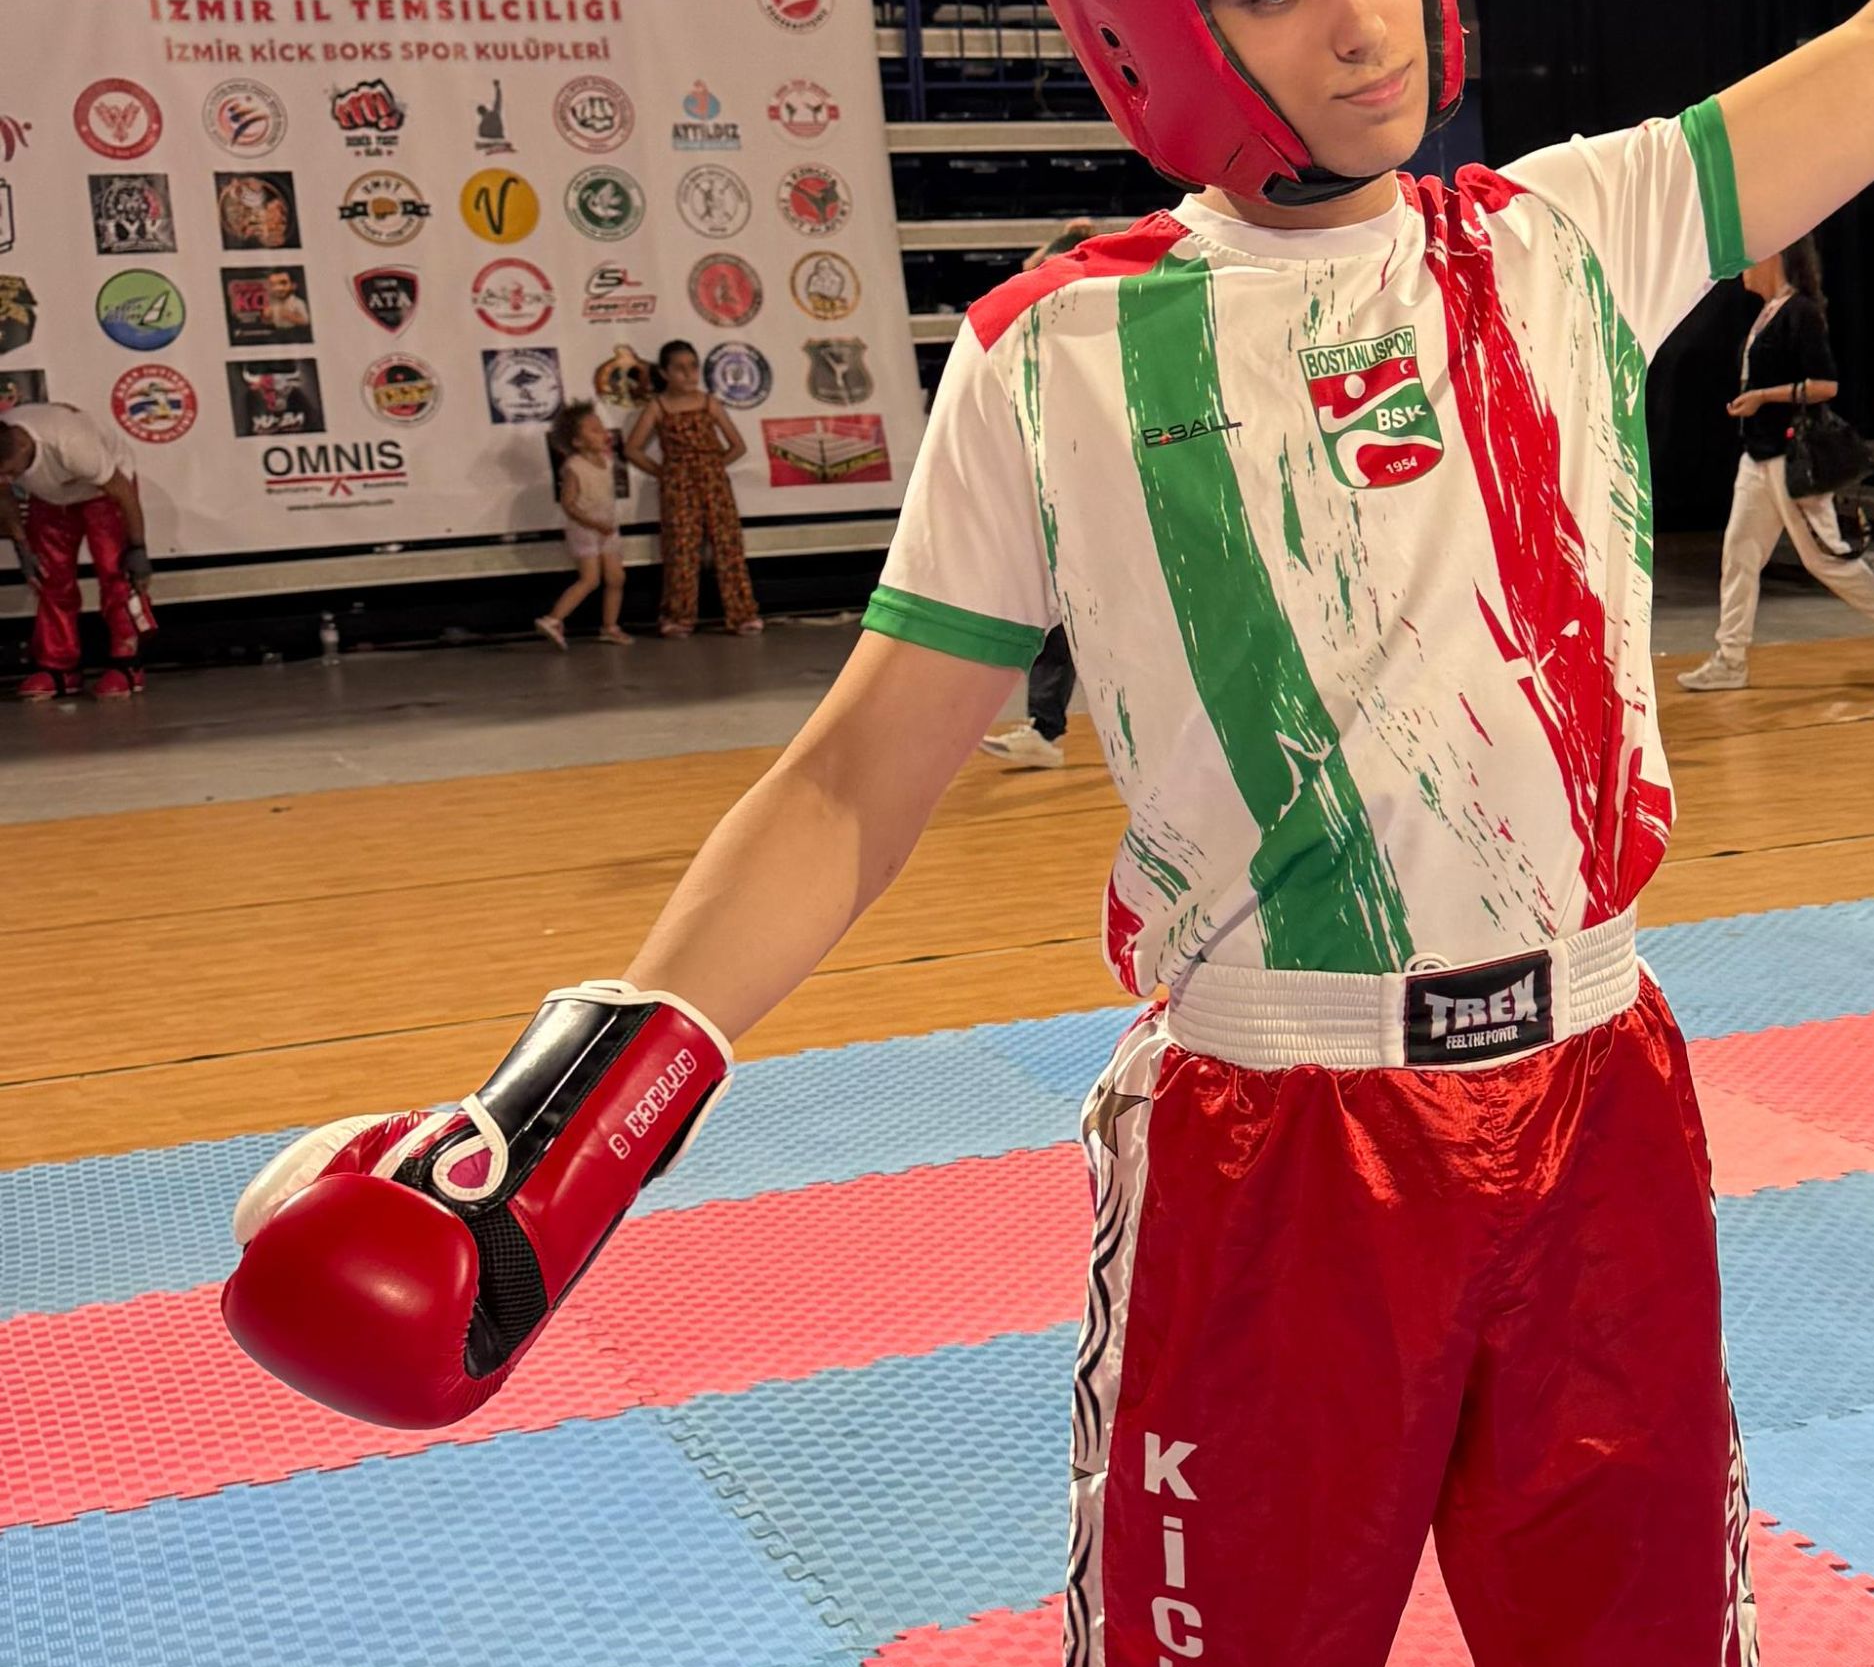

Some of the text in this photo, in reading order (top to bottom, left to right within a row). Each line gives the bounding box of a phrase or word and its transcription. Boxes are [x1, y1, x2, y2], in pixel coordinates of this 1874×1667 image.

[166, 36, 611, 64] İZMİR KİCK BOKS SPOR KULÜPLERİ
[368, 290, 412, 310] ATA
[1306, 331, 1415, 378] BOSTANLISPOR
[1375, 404, 1428, 432] BSK
[262, 440, 405, 477] OMNIS
[1384, 456, 1419, 475] 1954
[609, 1049, 697, 1160] ATTACK 6
